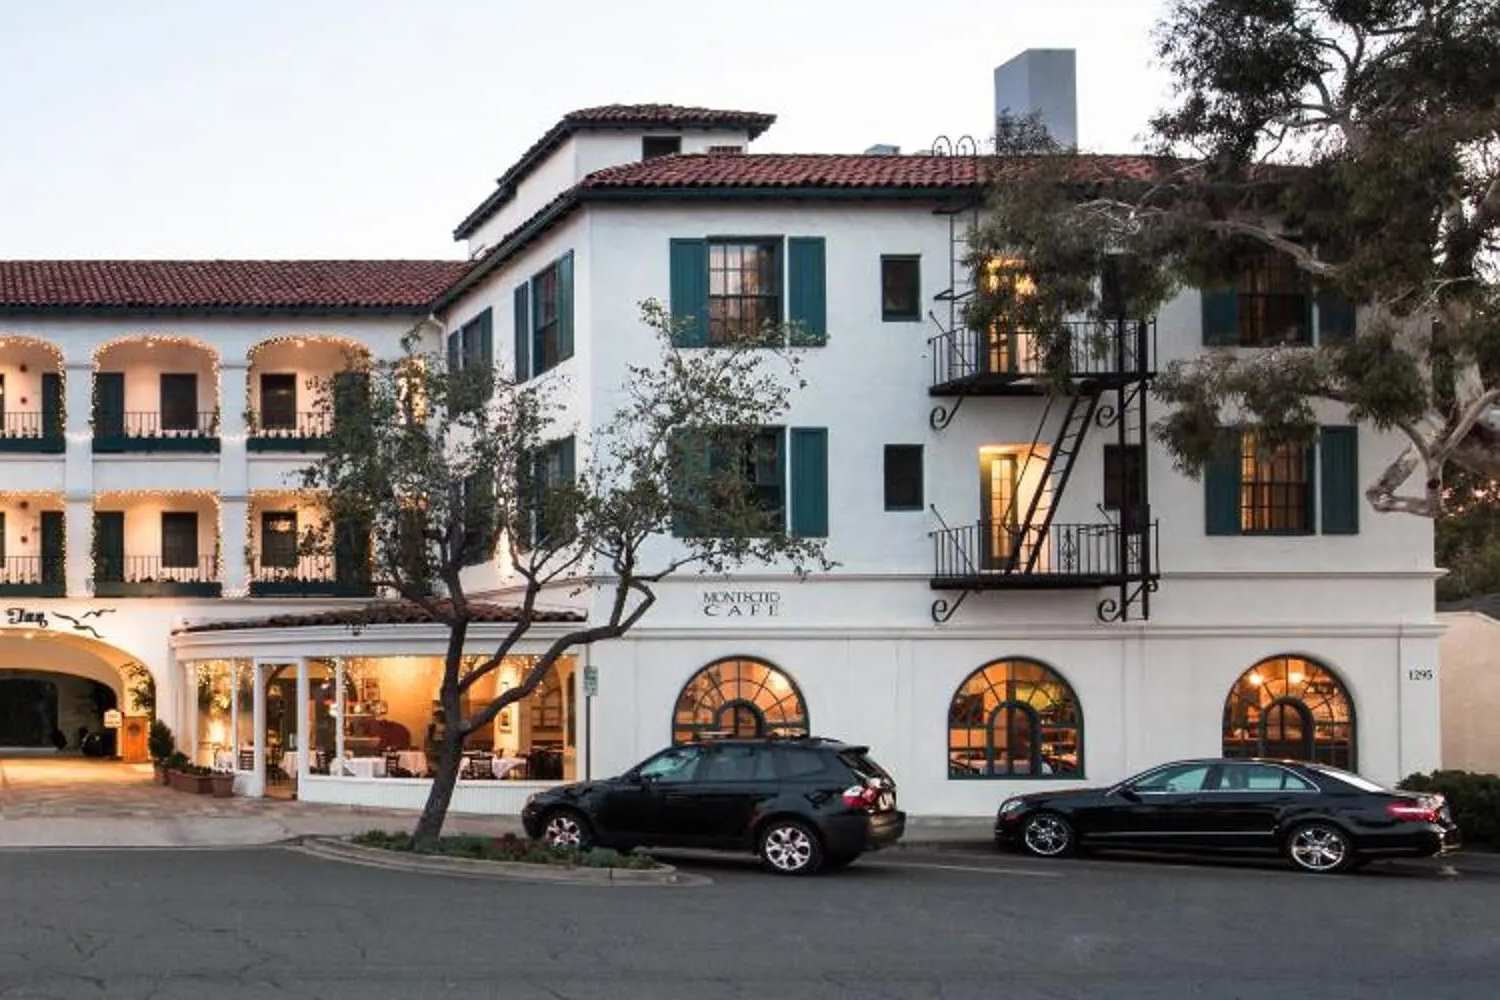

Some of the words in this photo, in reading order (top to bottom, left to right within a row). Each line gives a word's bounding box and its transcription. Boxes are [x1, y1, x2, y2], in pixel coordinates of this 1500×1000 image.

[703, 591, 781, 602] MONTECITO
[6, 607, 48, 628] Inn
[1409, 669, 1433, 681] 1295
